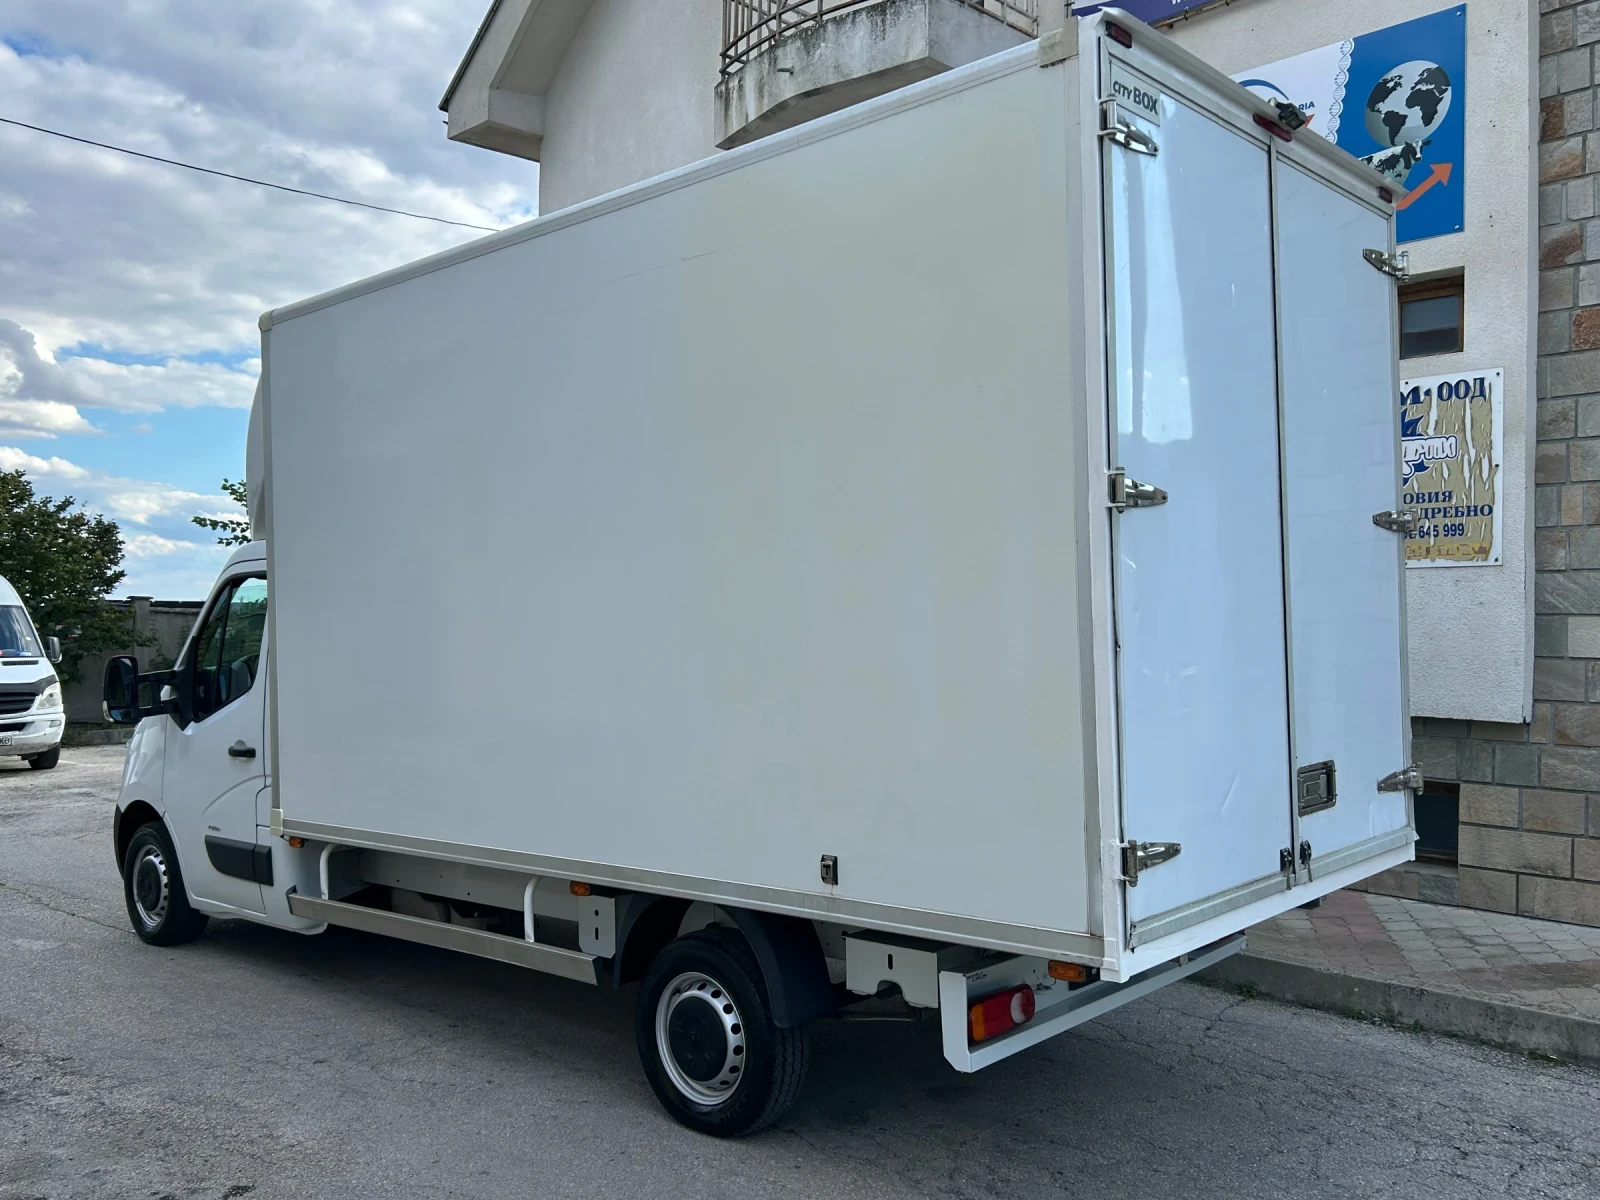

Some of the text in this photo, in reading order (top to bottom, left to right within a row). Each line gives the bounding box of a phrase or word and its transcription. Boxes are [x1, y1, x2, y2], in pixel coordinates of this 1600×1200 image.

[1437, 377, 1487, 404] ООД
[1403, 490, 1453, 505] ОВИЯ
[1443, 523, 1464, 538] 999
